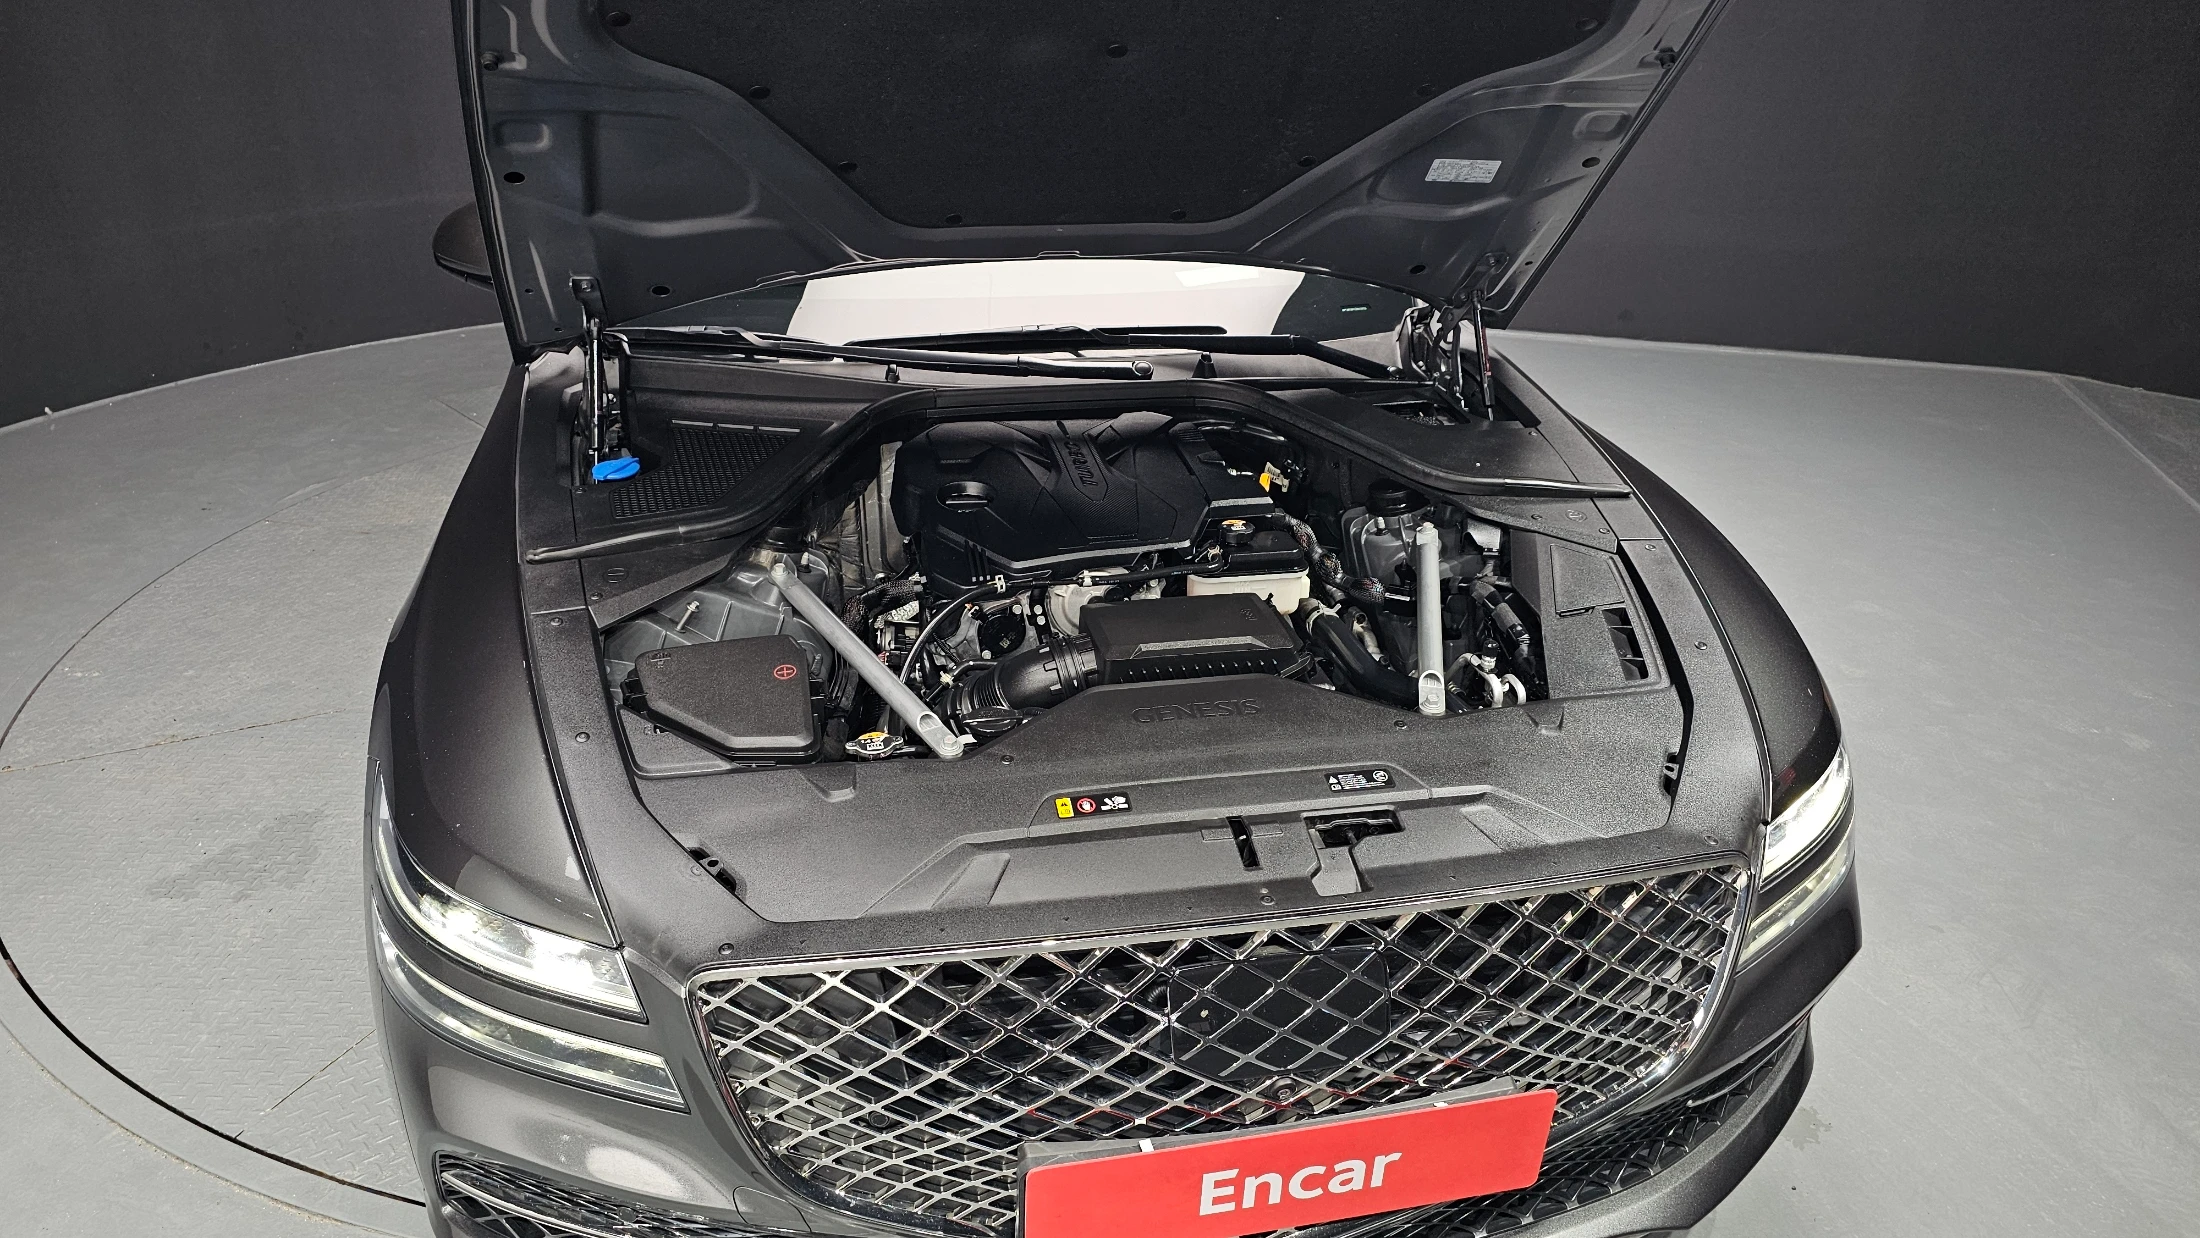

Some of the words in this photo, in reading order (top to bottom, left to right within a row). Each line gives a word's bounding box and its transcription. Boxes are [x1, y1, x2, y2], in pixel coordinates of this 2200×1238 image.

[1063, 441, 1099, 487] TURBO
[1131, 698, 1261, 723] GENESIS
[1199, 1150, 1403, 1217] Encar
